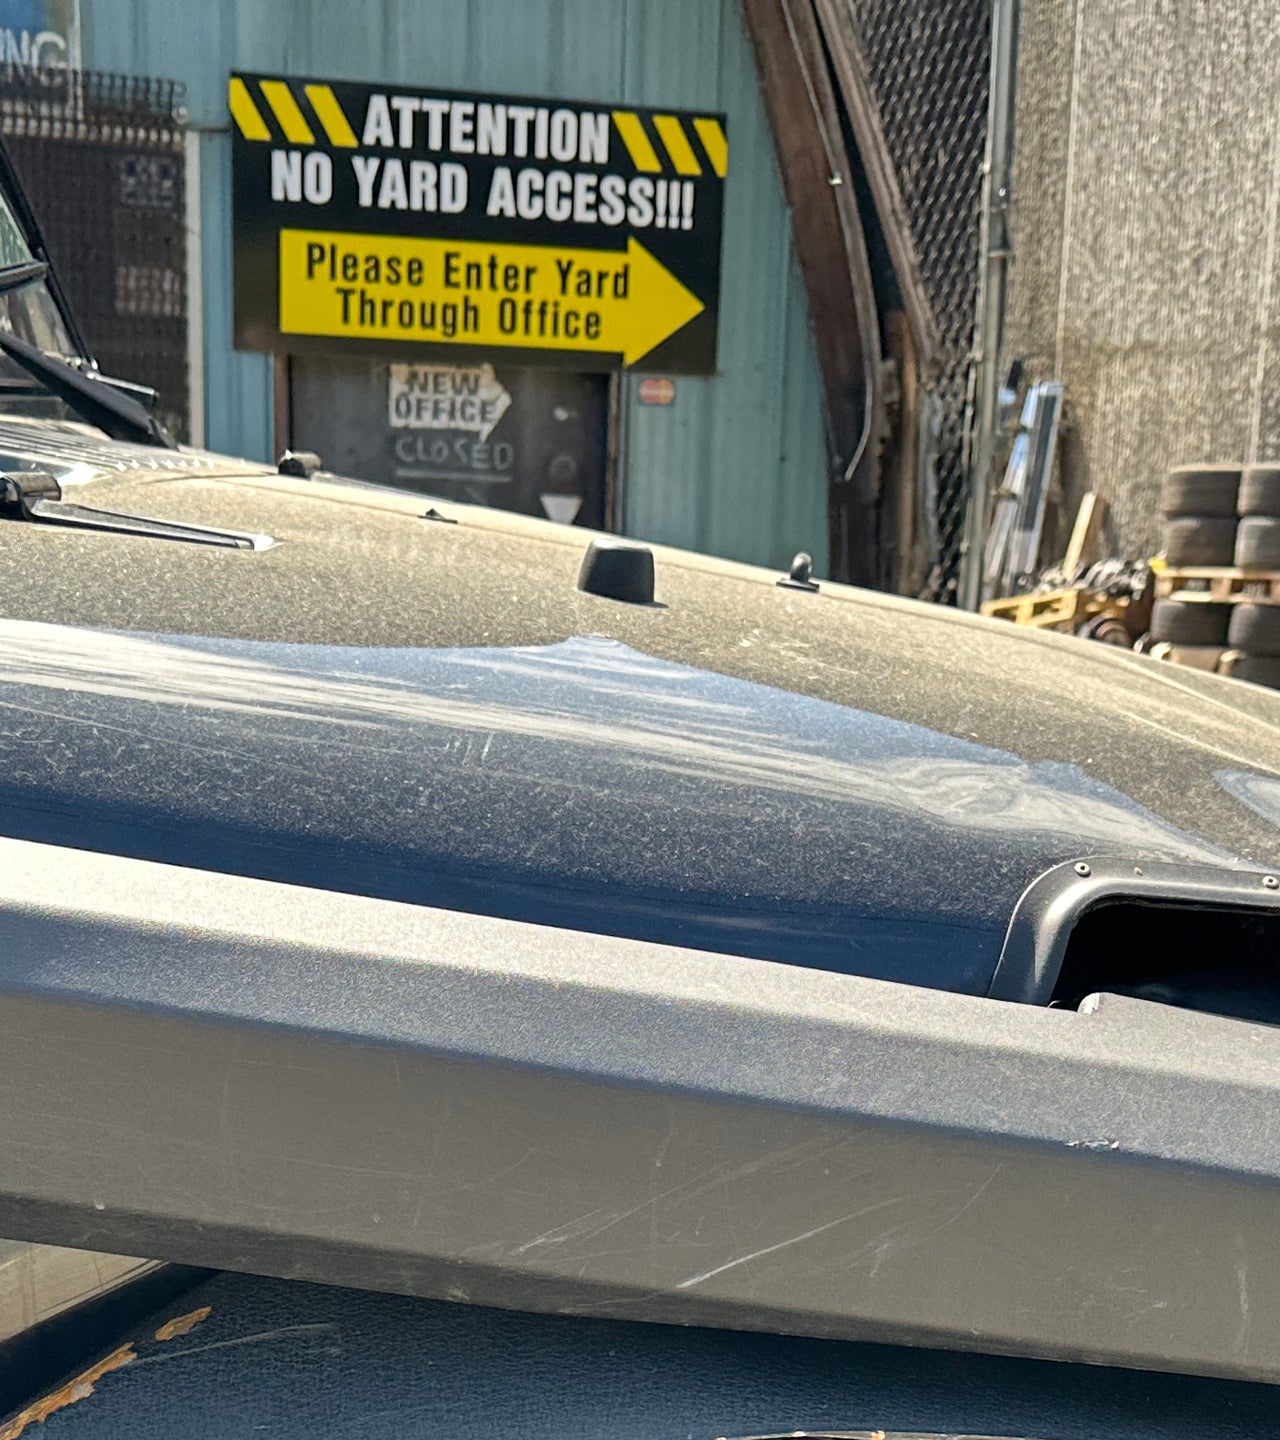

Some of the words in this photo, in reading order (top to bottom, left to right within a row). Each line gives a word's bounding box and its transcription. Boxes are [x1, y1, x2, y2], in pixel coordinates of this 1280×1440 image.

[362, 94, 609, 164] ATTENTION
[270, 150, 333, 203] NO
[352, 155, 468, 213] YARD
[486, 167, 694, 230] ACCESS!!!
[306, 242, 423, 285] Please
[445, 252, 537, 293] Enter
[556, 259, 629, 299] Yard
[337, 288, 479, 337] Through
[499, 298, 601, 340] Office
[408, 367, 481, 396] NEW
[394, 394, 498, 424] OFFICE
[395, 436, 514, 472] CLOSED
